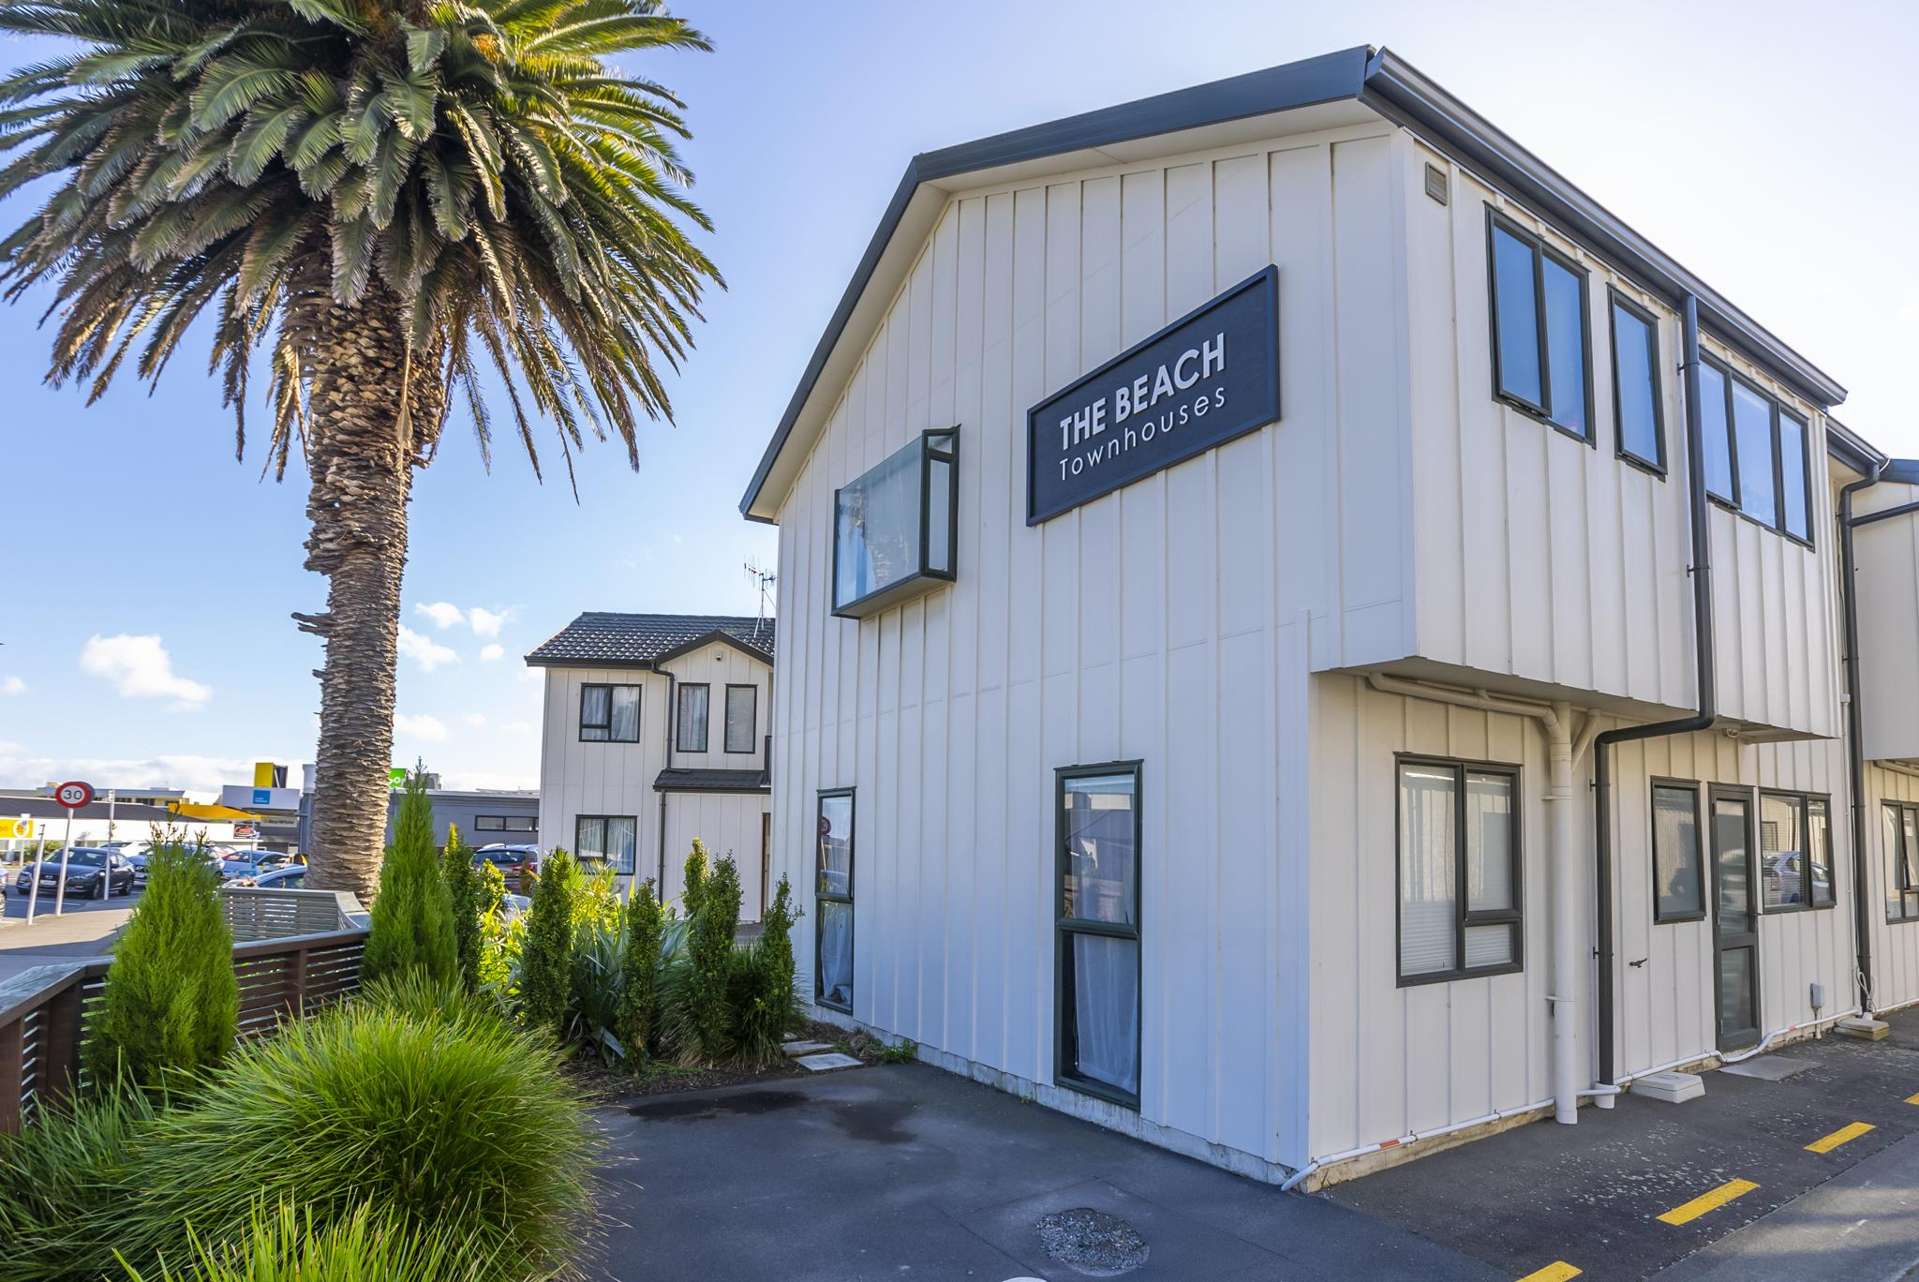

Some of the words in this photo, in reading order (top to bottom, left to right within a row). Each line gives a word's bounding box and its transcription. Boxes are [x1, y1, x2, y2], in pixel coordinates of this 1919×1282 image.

[1059, 397, 1106, 451] THE
[1115, 332, 1225, 424] BEACH
[1059, 387, 1225, 481] Townhouses
[63, 789, 82, 800] 30
